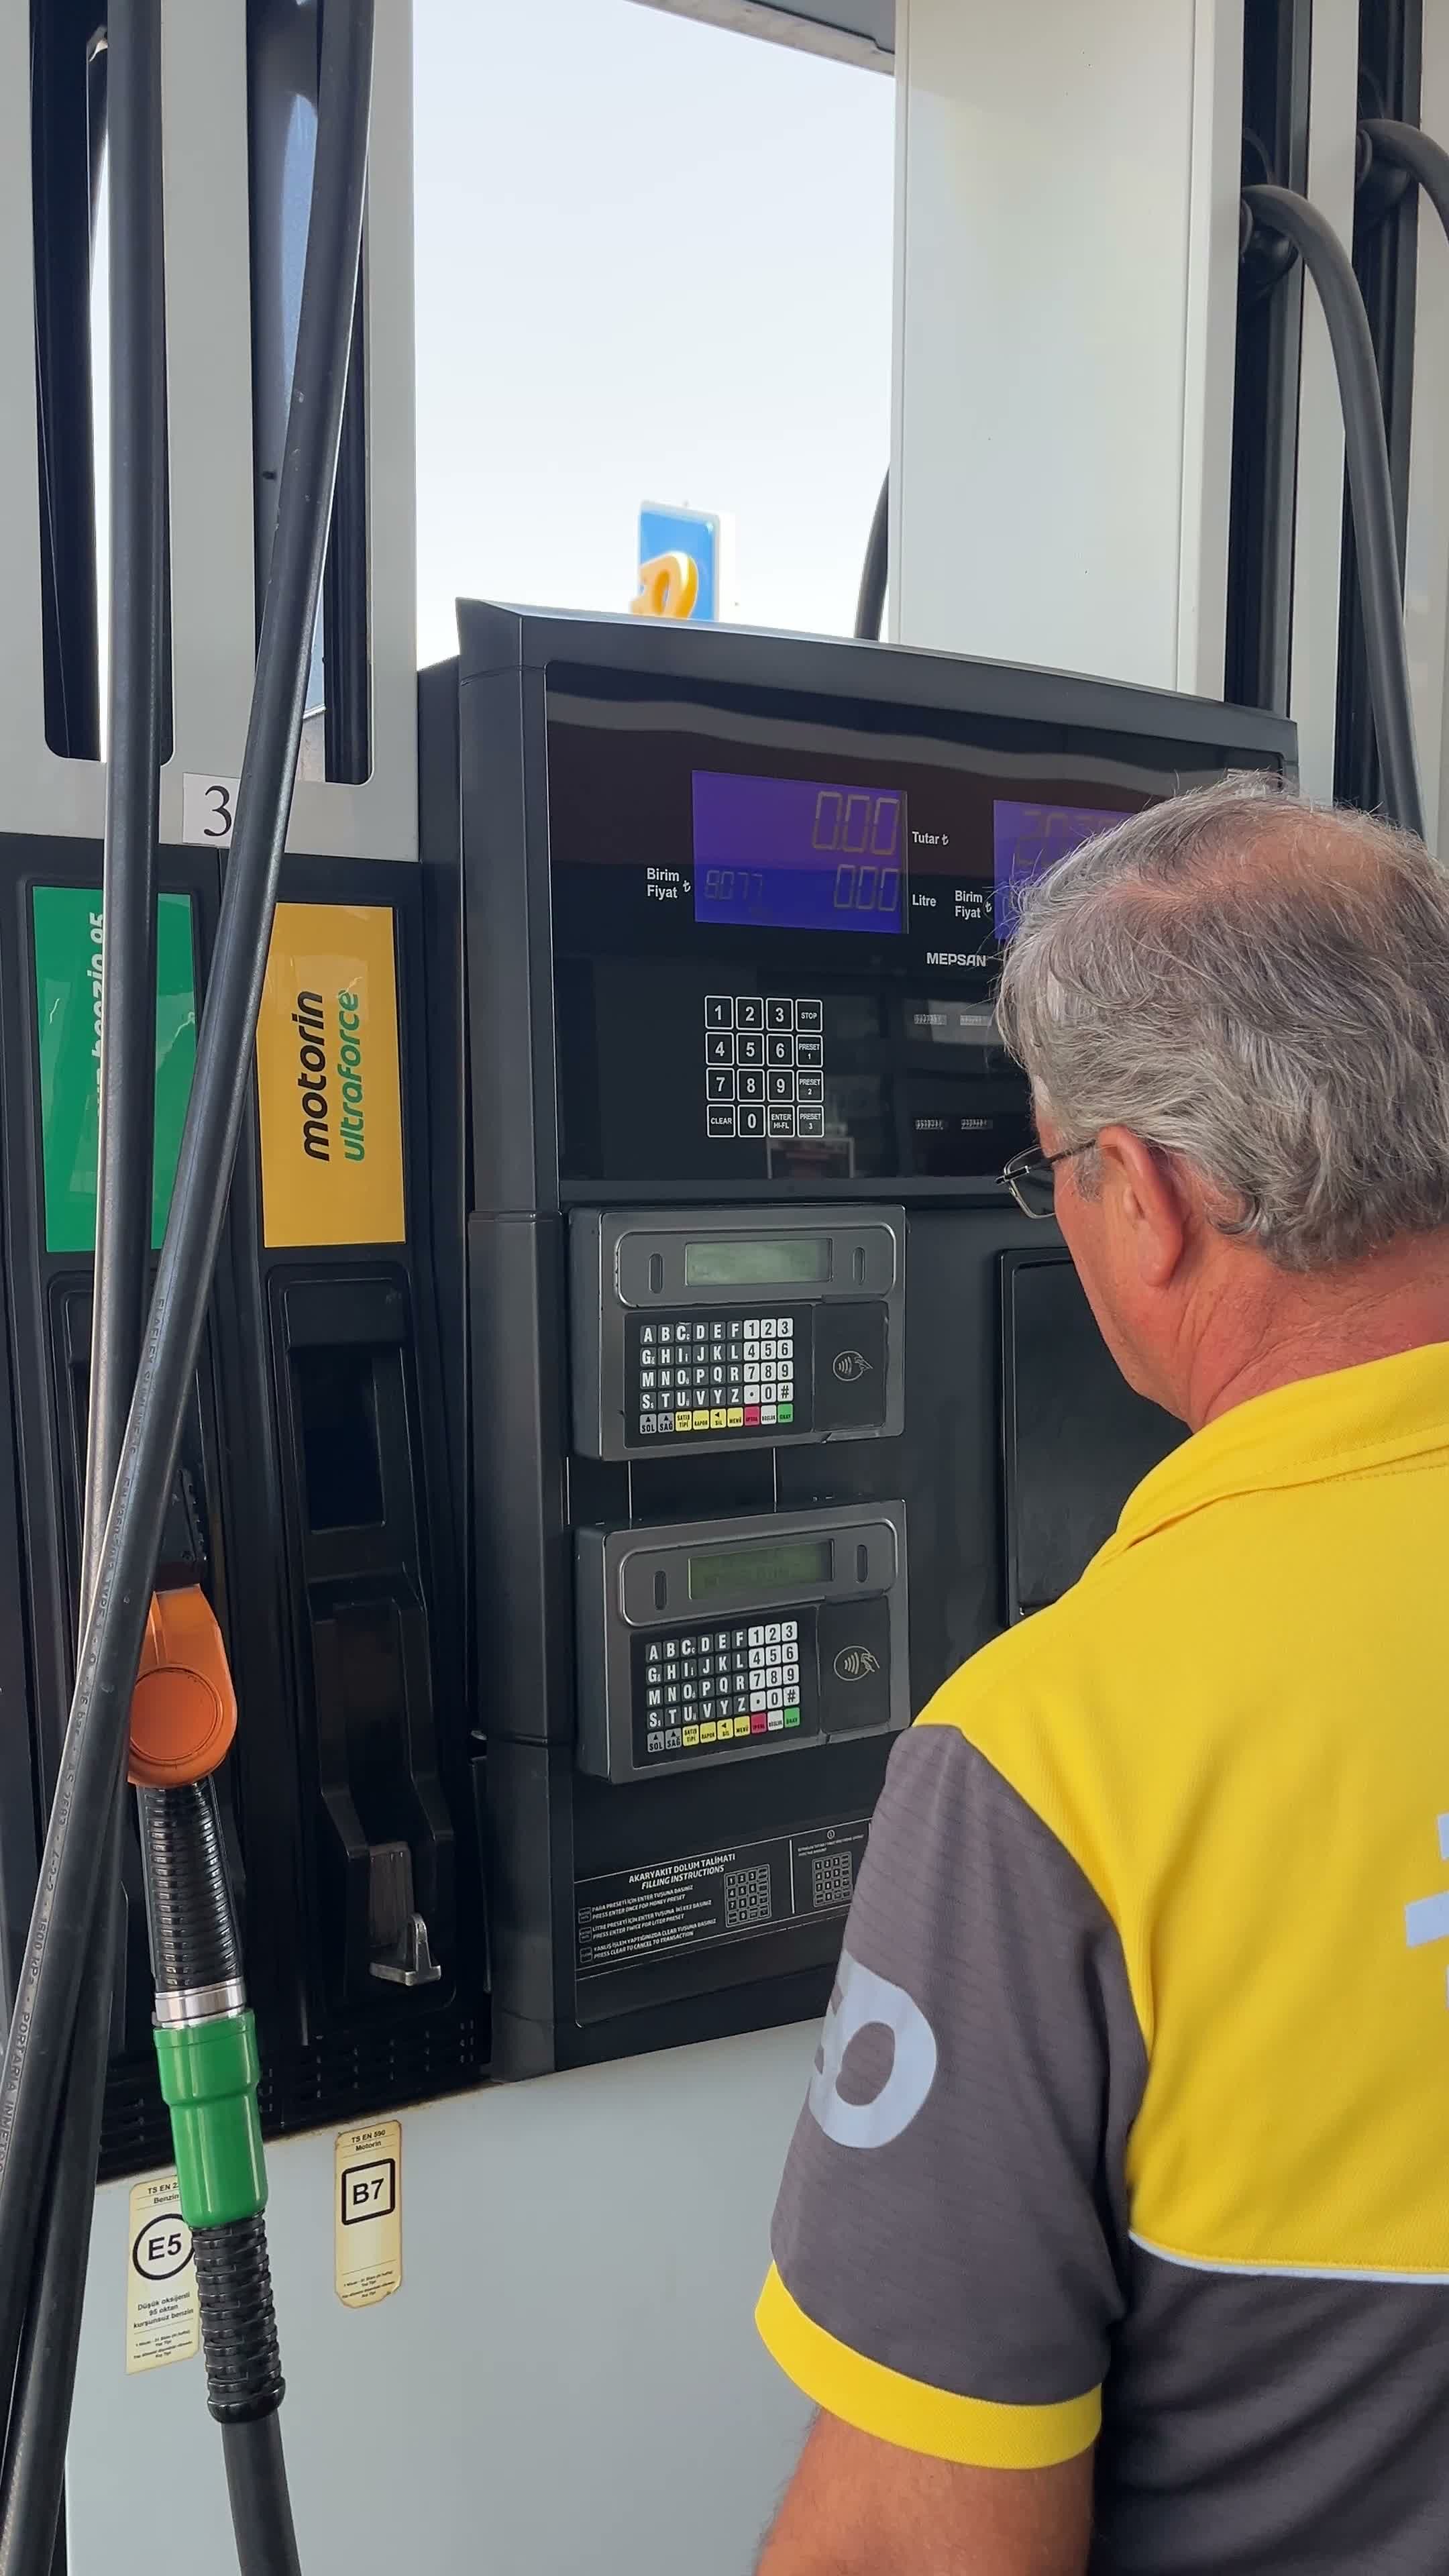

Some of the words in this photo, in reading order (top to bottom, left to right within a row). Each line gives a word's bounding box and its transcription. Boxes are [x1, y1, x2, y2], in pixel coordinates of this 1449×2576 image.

[203, 785, 232, 837] 3
[912, 831, 939, 844] Tutar
[647, 867, 680, 881] Birim
[647, 884, 678, 900] Fiyat
[912, 894, 936, 907] Litre
[955, 890, 982, 903] Birim
[955, 906, 981, 920] Fiyat
[926, 952, 987, 967] MEPSAN
[714, 1005, 721, 1020] 1
[745, 1006, 755, 1022] 2
[775, 1008, 784, 1022] 3
[801, 1012, 817, 1020] STOP
[715, 1041, 725, 1057] 4
[746, 1042, 755, 1057] 5
[775, 1042, 785, 1058] 6
[291, 991, 330, 1162] motorin
[336, 989, 366, 1161] ultraforce
[716, 1077, 725, 1092] 7
[747, 1078, 755, 1093] 8
[776, 1078, 786, 1093] 9
[747, 1113, 757, 1128] 0
[643, 1327, 653, 1342] A
[661, 1326, 670, 1342] B
[696, 1325, 704, 1340] D
[714, 1324, 722, 1338] E
[732, 1323, 739, 1337] F
[749, 1322, 755, 1336] 1
[765, 1322, 772, 1336] 2
[782, 1321, 788, 1334] 3
[661, 1349, 670, 1363] H
[697, 1347, 704, 1361] J
[713, 1346, 722, 1360] K
[731, 1345, 738, 1359] L
[748, 1344, 755, 1357] 4
[765, 1344, 772, 1356] 5
[782, 1342, 788, 1356] 6
[642, 1372, 654, 1387] M
[661, 1371, 670, 1385] N
[696, 1368, 704, 1384] P
[713, 1366, 722, 1383] Q
[731, 1366, 739, 1381] R
[748, 1366, 755, 1379] 7
[765, 1365, 772, 1378] 8
[782, 1364, 788, 1377] 9
[661, 1393, 670, 1407] T
[696, 1391, 705, 1405] V
[714, 1389, 722, 1404] Y
[731, 1389, 739, 1403] Z
[765, 1387, 772, 1399] 0
[649, 1645, 658, 1660] A
[667, 1643, 676, 1657] B
[701, 1638, 710, 1652] D
[719, 1634, 726, 1649] E
[737, 1631, 743, 1646] F
[753, 1629, 759, 1644] 1
[769, 1627, 776, 1641] 2
[786, 1625, 792, 1638] 3
[667, 1664, 676, 1680] H
[703, 1659, 710, 1674] J
[719, 1656, 727, 1671] K
[737, 1654, 743, 1668] L
[753, 1651, 761, 1664] 4
[770, 1649, 777, 1662] 5
[786, 1646, 794, 1659] 6
[649, 1690, 661, 1705] M
[668, 1686, 676, 1701] N
[702, 1681, 711, 1696] P
[719, 1677, 729, 1693] Q
[737, 1676, 745, 1690] R
[754, 1673, 761, 1686] 7
[771, 1670, 777, 1684] 8
[788, 1668, 794, 1681] 9
[669, 1709, 677, 1723] T
[704, 1703, 712, 1718] V
[720, 1700, 729, 1715] Y
[738, 1697, 746, 1712] Z
[771, 1693, 778, 1705] 0
[629, 1867, 672, 1883] AKARYAKIT
[674, 1861, 700, 1873] DOLUM
[701, 1854, 735, 1867] TALİMATI
[641, 1877, 669, 1890] FILLING
[671, 1864, 724, 1883] INSTRUCTIONS
[356, 2141, 381, 2151] Motorin
[362, 2132, 372, 2140] EN
[154, 2193, 179, 2204] Benzin
[353, 2178, 384, 2205] B7
[148, 2233, 181, 2261] E5
